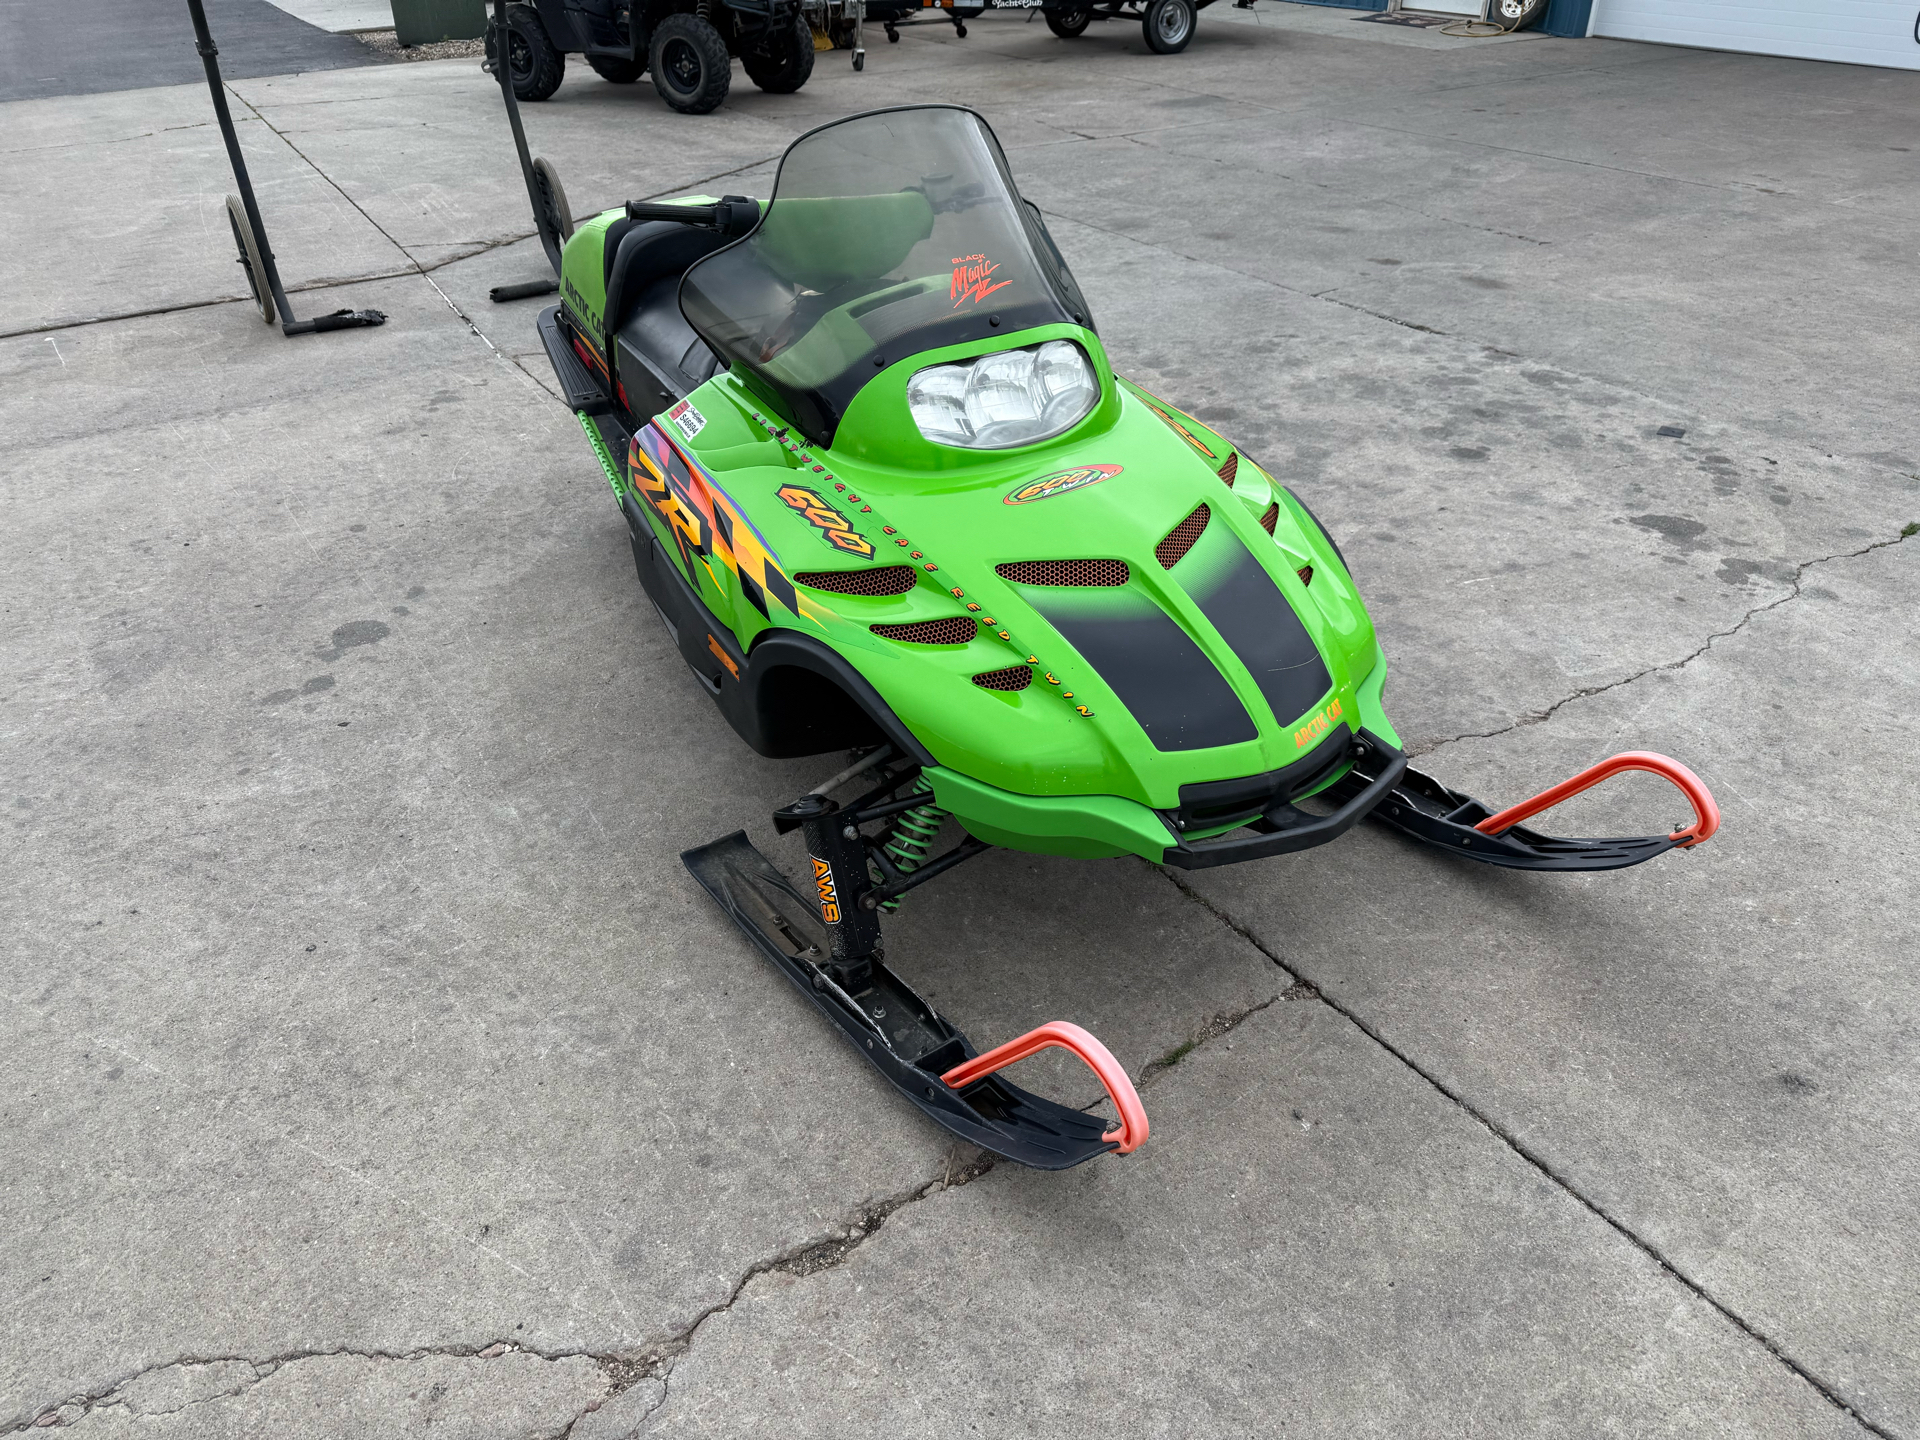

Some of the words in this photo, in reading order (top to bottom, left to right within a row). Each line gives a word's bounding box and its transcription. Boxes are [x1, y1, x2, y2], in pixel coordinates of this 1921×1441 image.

[950, 260, 1001, 300] Magic
[951, 253, 986, 264] BLACK
[565, 276, 589, 323] ARCTIC
[1014, 470, 1096, 500] 600
[775, 484, 875, 560] 600
[882, 525, 938, 573] CASE
[951, 586, 1011, 641] REED
[1025, 654, 1095, 718] TWIN
[1294, 712, 1329, 749] ARCTIC
[1326, 698, 1343, 722] CAT
[810, 857, 839, 923] AWS
